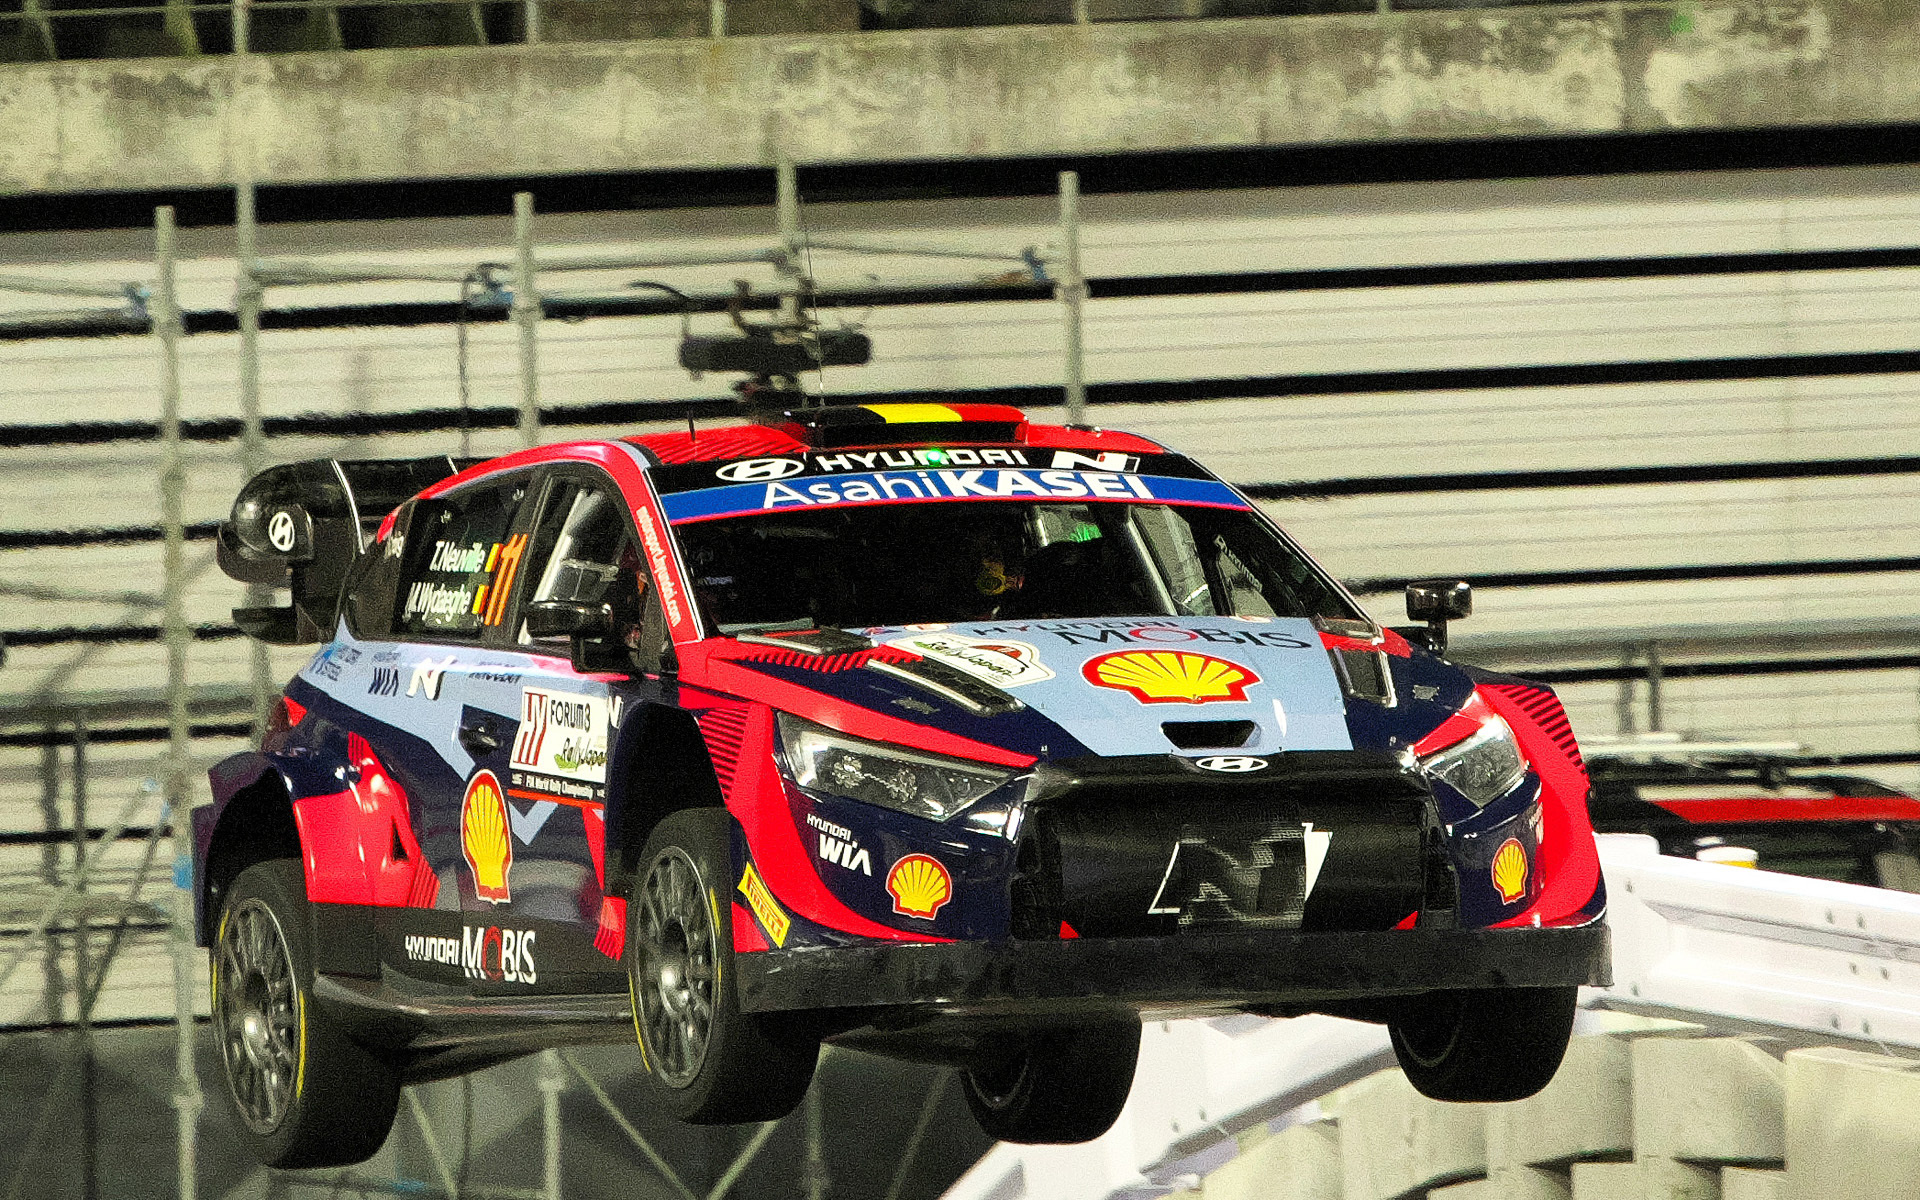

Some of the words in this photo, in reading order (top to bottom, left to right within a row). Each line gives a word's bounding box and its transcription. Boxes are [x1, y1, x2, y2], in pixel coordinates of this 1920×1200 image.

[1054, 626, 1312, 649] MOBIS
[806, 813, 851, 841] HYUNDAI
[819, 833, 872, 877] WIA
[405, 935, 460, 966] HYUNDAI
[462, 925, 537, 985] MOBIS
